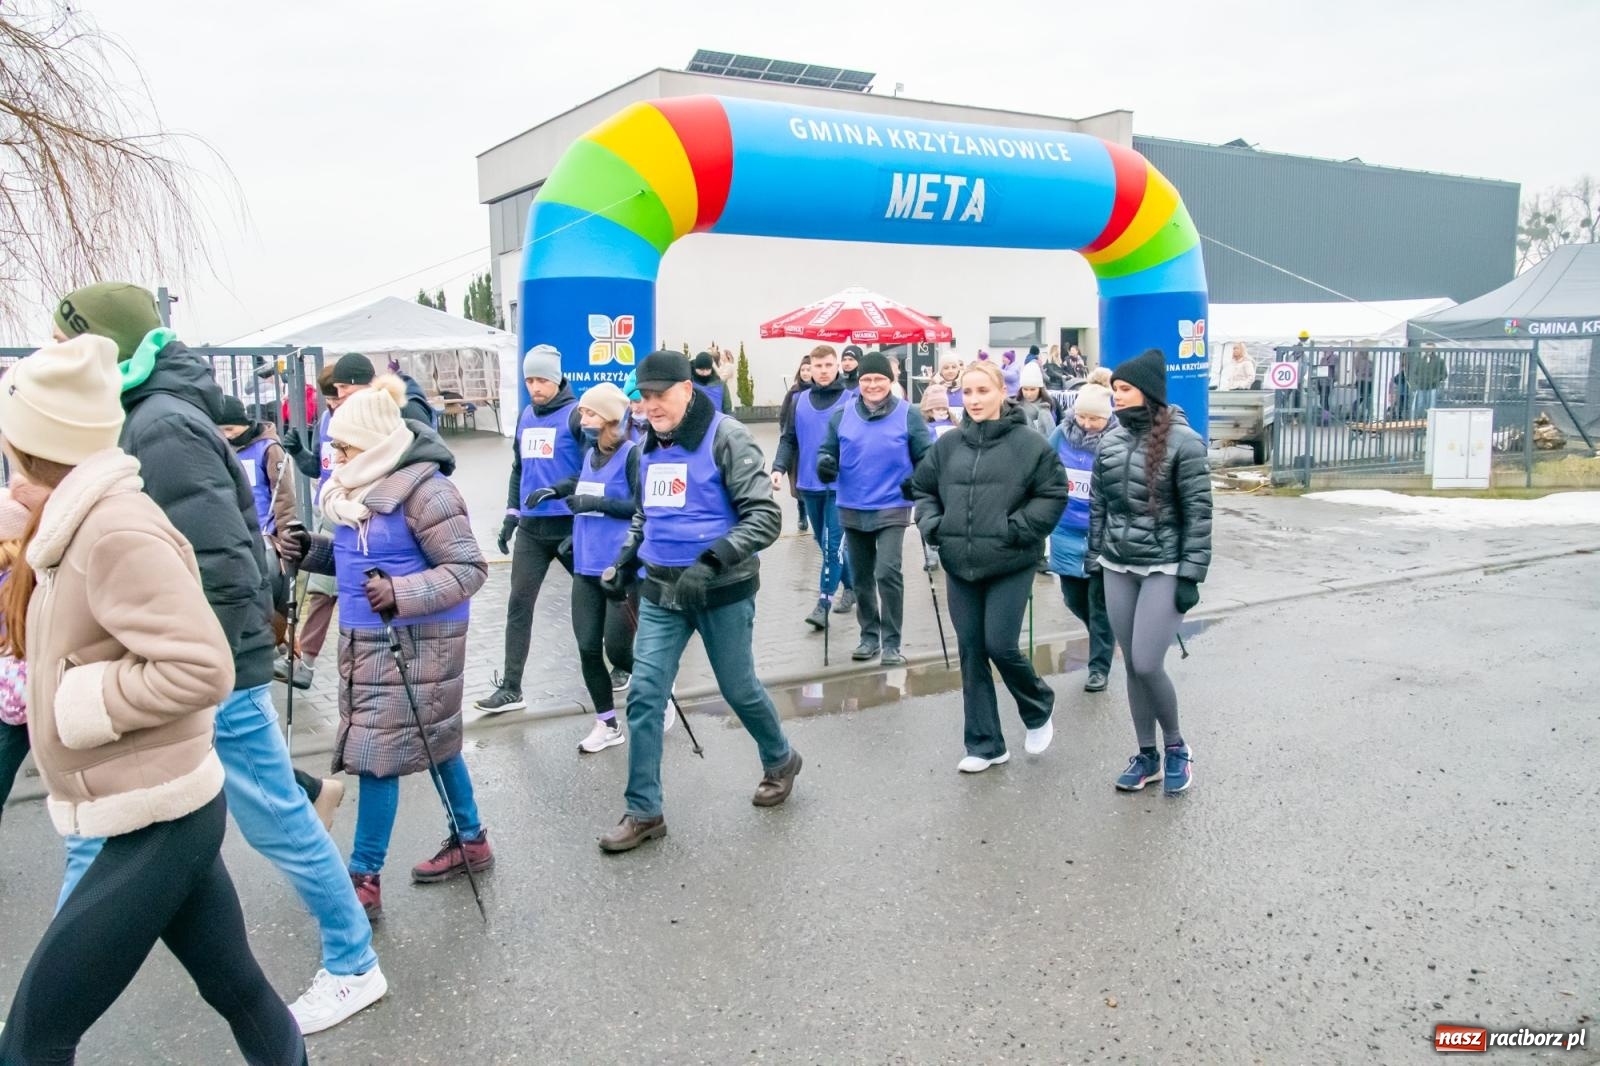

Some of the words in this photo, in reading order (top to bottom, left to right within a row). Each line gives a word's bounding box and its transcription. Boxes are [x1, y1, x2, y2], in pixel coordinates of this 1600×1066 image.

[789, 117, 882, 147] GMINA
[888, 128, 1072, 161] KRZYŻANOWICE
[884, 172, 986, 222] META
[1528, 322, 1578, 335] GMINA
[1582, 320, 1600, 334] KR
[1166, 363, 1181, 372] INA
[563, 372, 591, 382] MINA
[593, 370, 631, 382] KRZYŻA
[1277, 370, 1291, 381] 20
[528, 439, 546, 451] 117
[651, 480, 673, 497] 101
